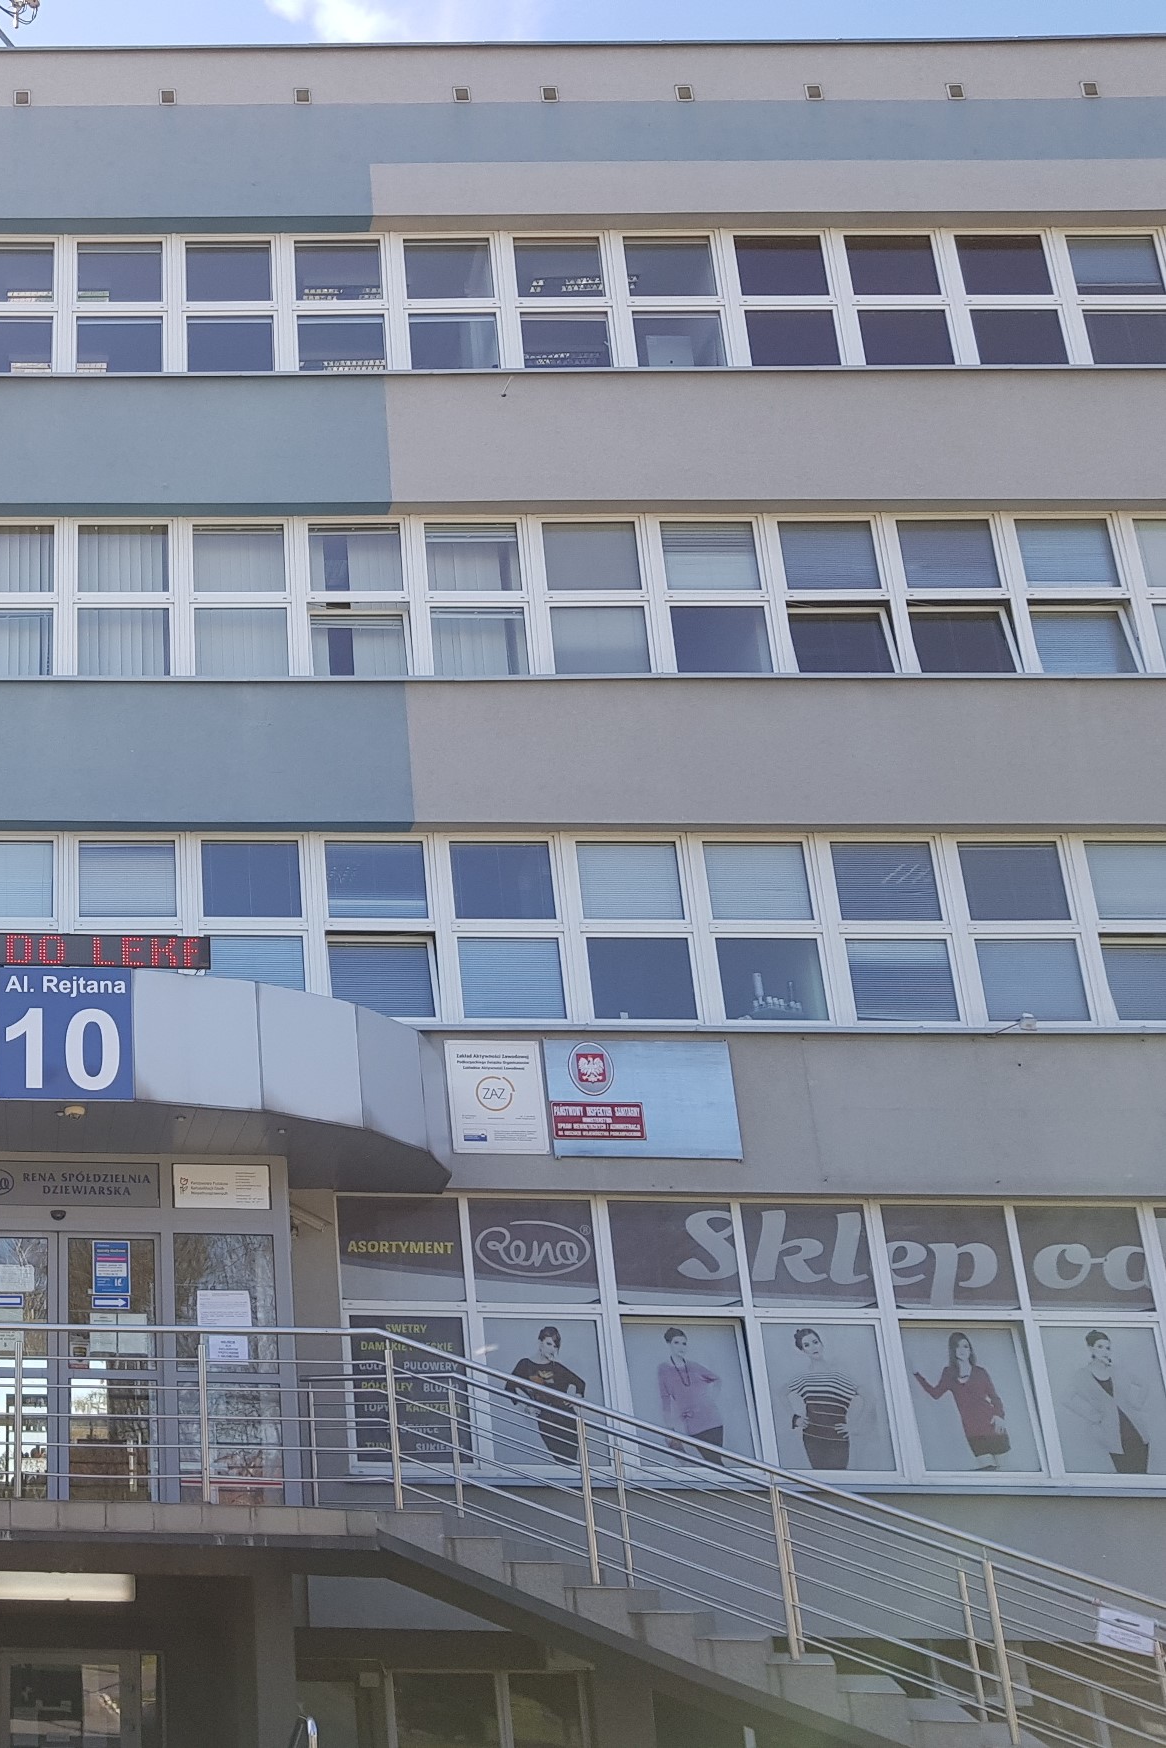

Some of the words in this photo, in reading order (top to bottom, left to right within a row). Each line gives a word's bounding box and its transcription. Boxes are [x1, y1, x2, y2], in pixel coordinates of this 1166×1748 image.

[6, 935, 65, 964] DO
[5, 975, 34, 993] Al.
[42, 975, 126, 998] Rejtana
[5, 1008, 120, 1091] 10
[482, 1088, 506, 1100] ZAZ
[23, 1172, 56, 1182] RENA
[61, 1171, 151, 1184] SPÓŁDZIELNIA
[42, 1185, 131, 1196] DZIEWIARSKA
[347, 1240, 455, 1255] ASORTYMENT
[479, 1226, 582, 1268] Rena
[677, 1209, 999, 1306] Sklep
[386, 1324, 427, 1333] SWETRY
[403, 1361, 458, 1371] PULOWERY
